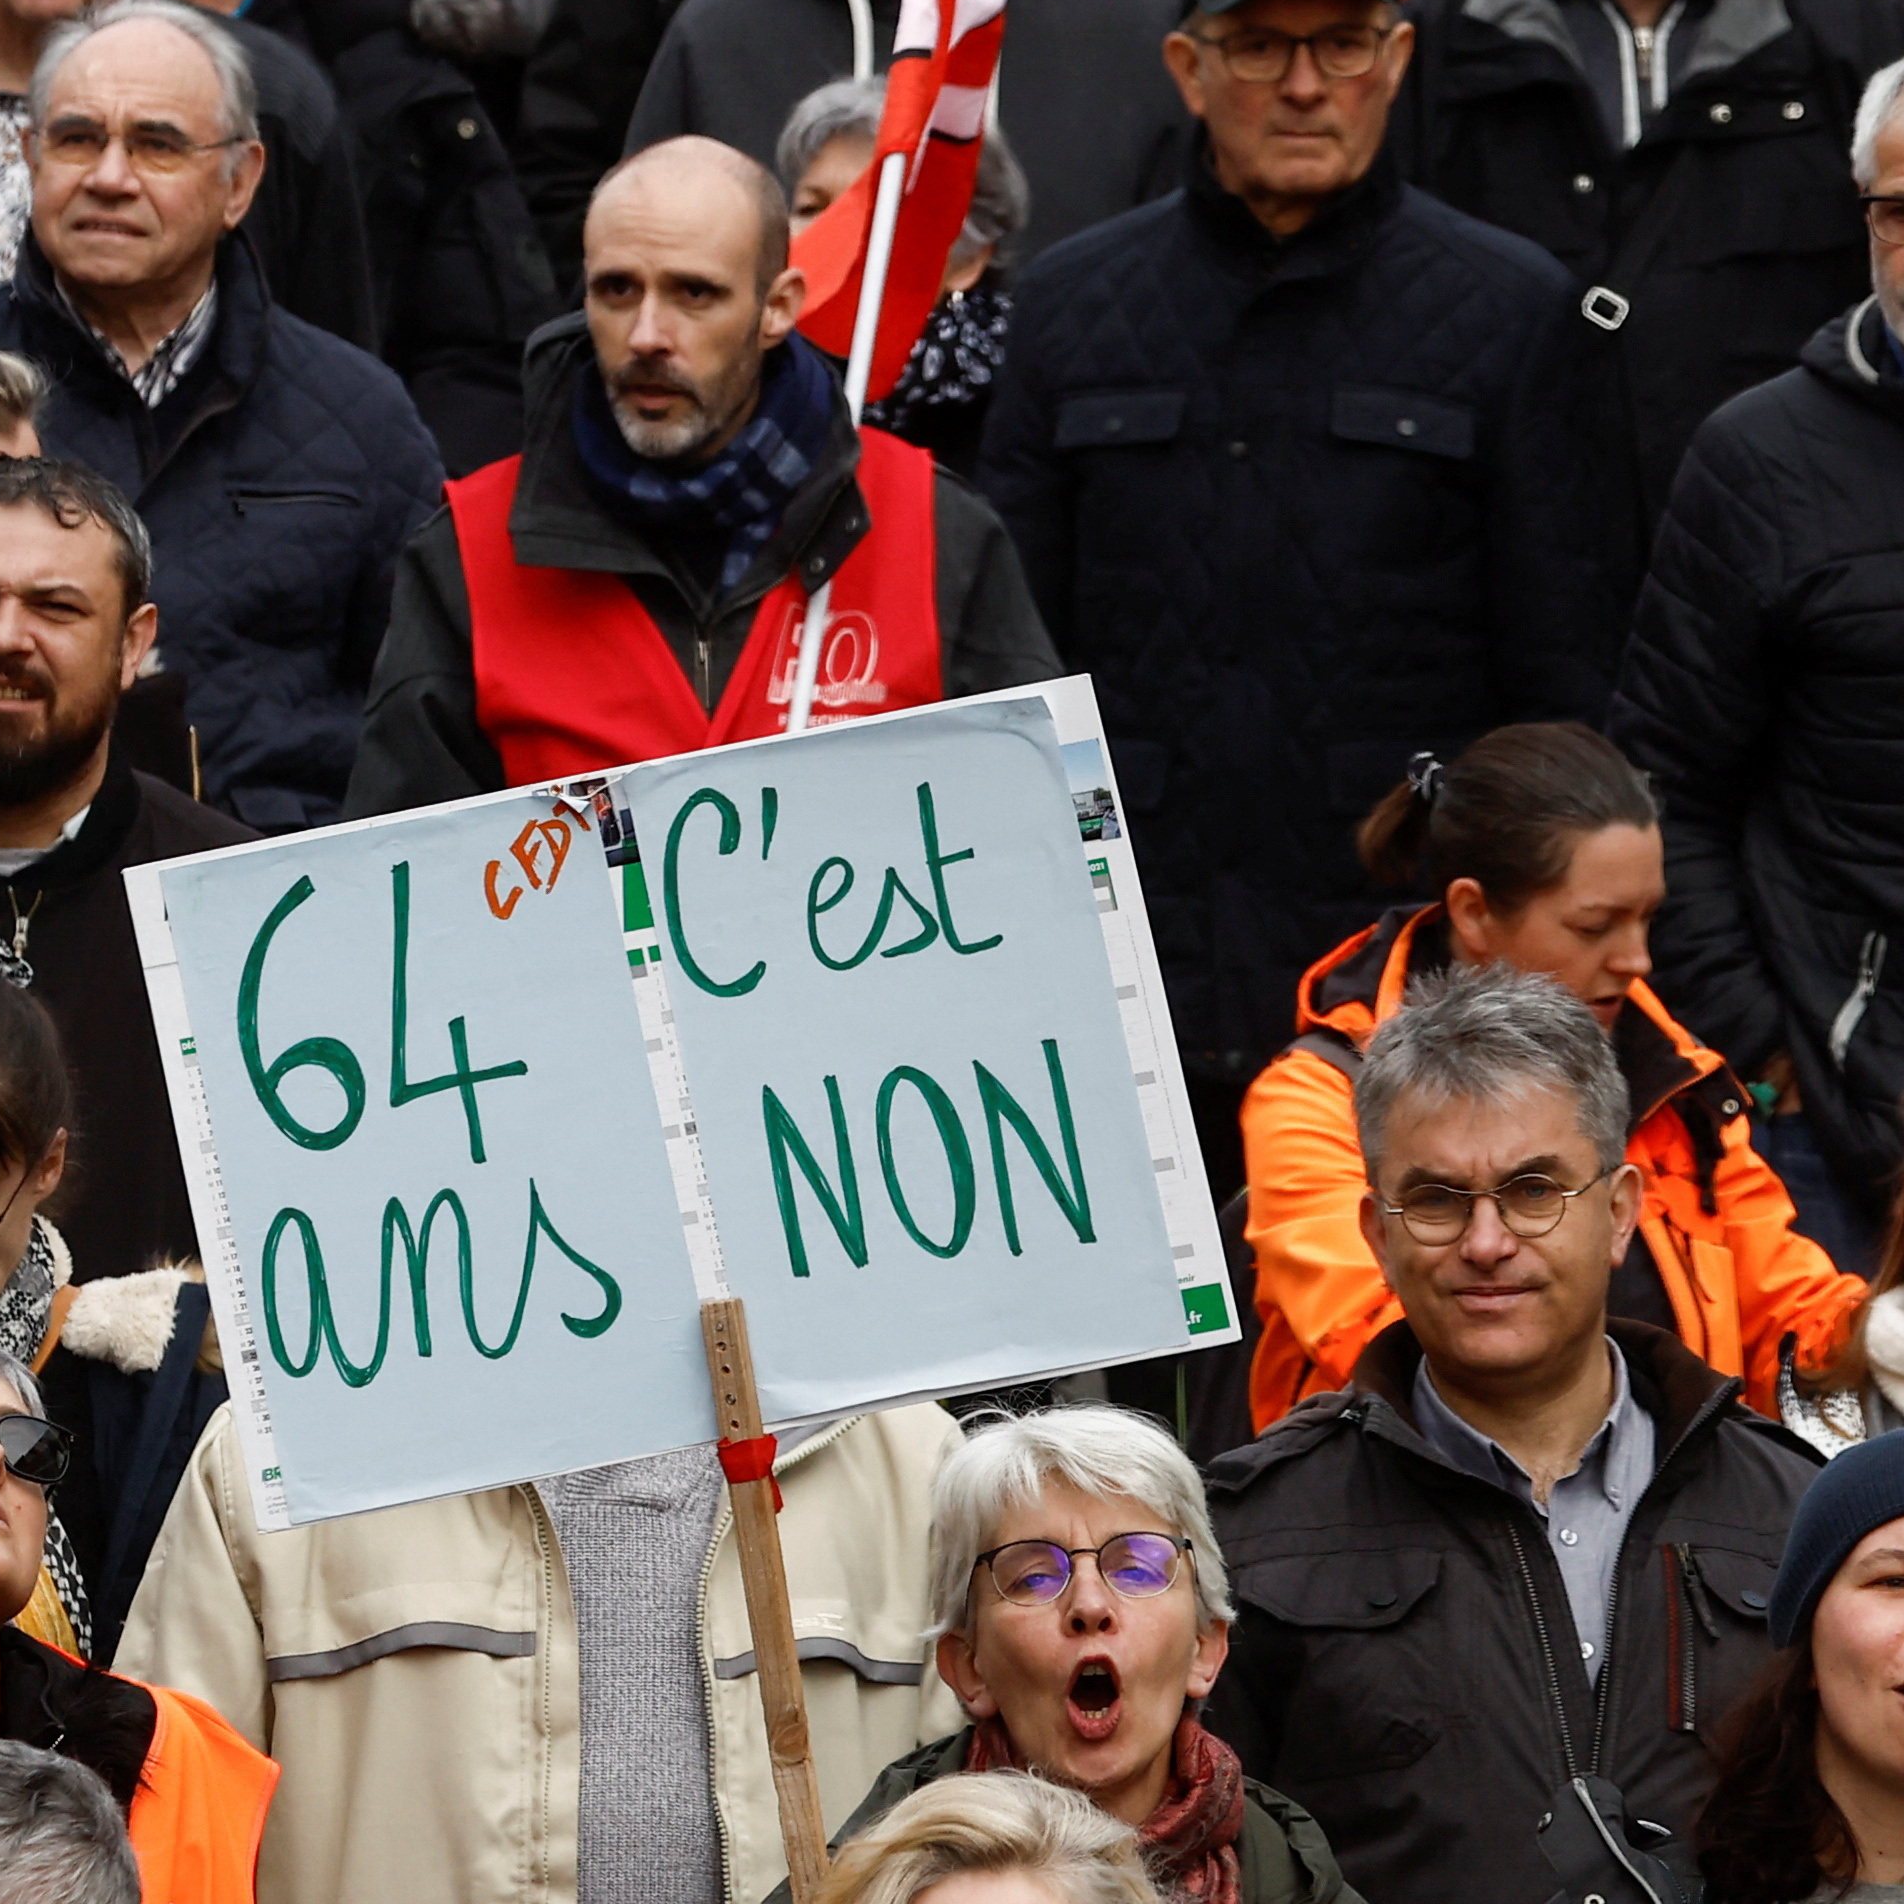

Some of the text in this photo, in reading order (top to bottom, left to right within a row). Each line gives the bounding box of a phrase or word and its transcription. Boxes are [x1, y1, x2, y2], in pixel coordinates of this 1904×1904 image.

[484, 800, 592, 921] CFDT
[664, 782, 1003, 998] C'est
[238, 861, 528, 1164] 64
[763, 1039, 1097, 1278] NON
[261, 1177, 622, 1388] ans
